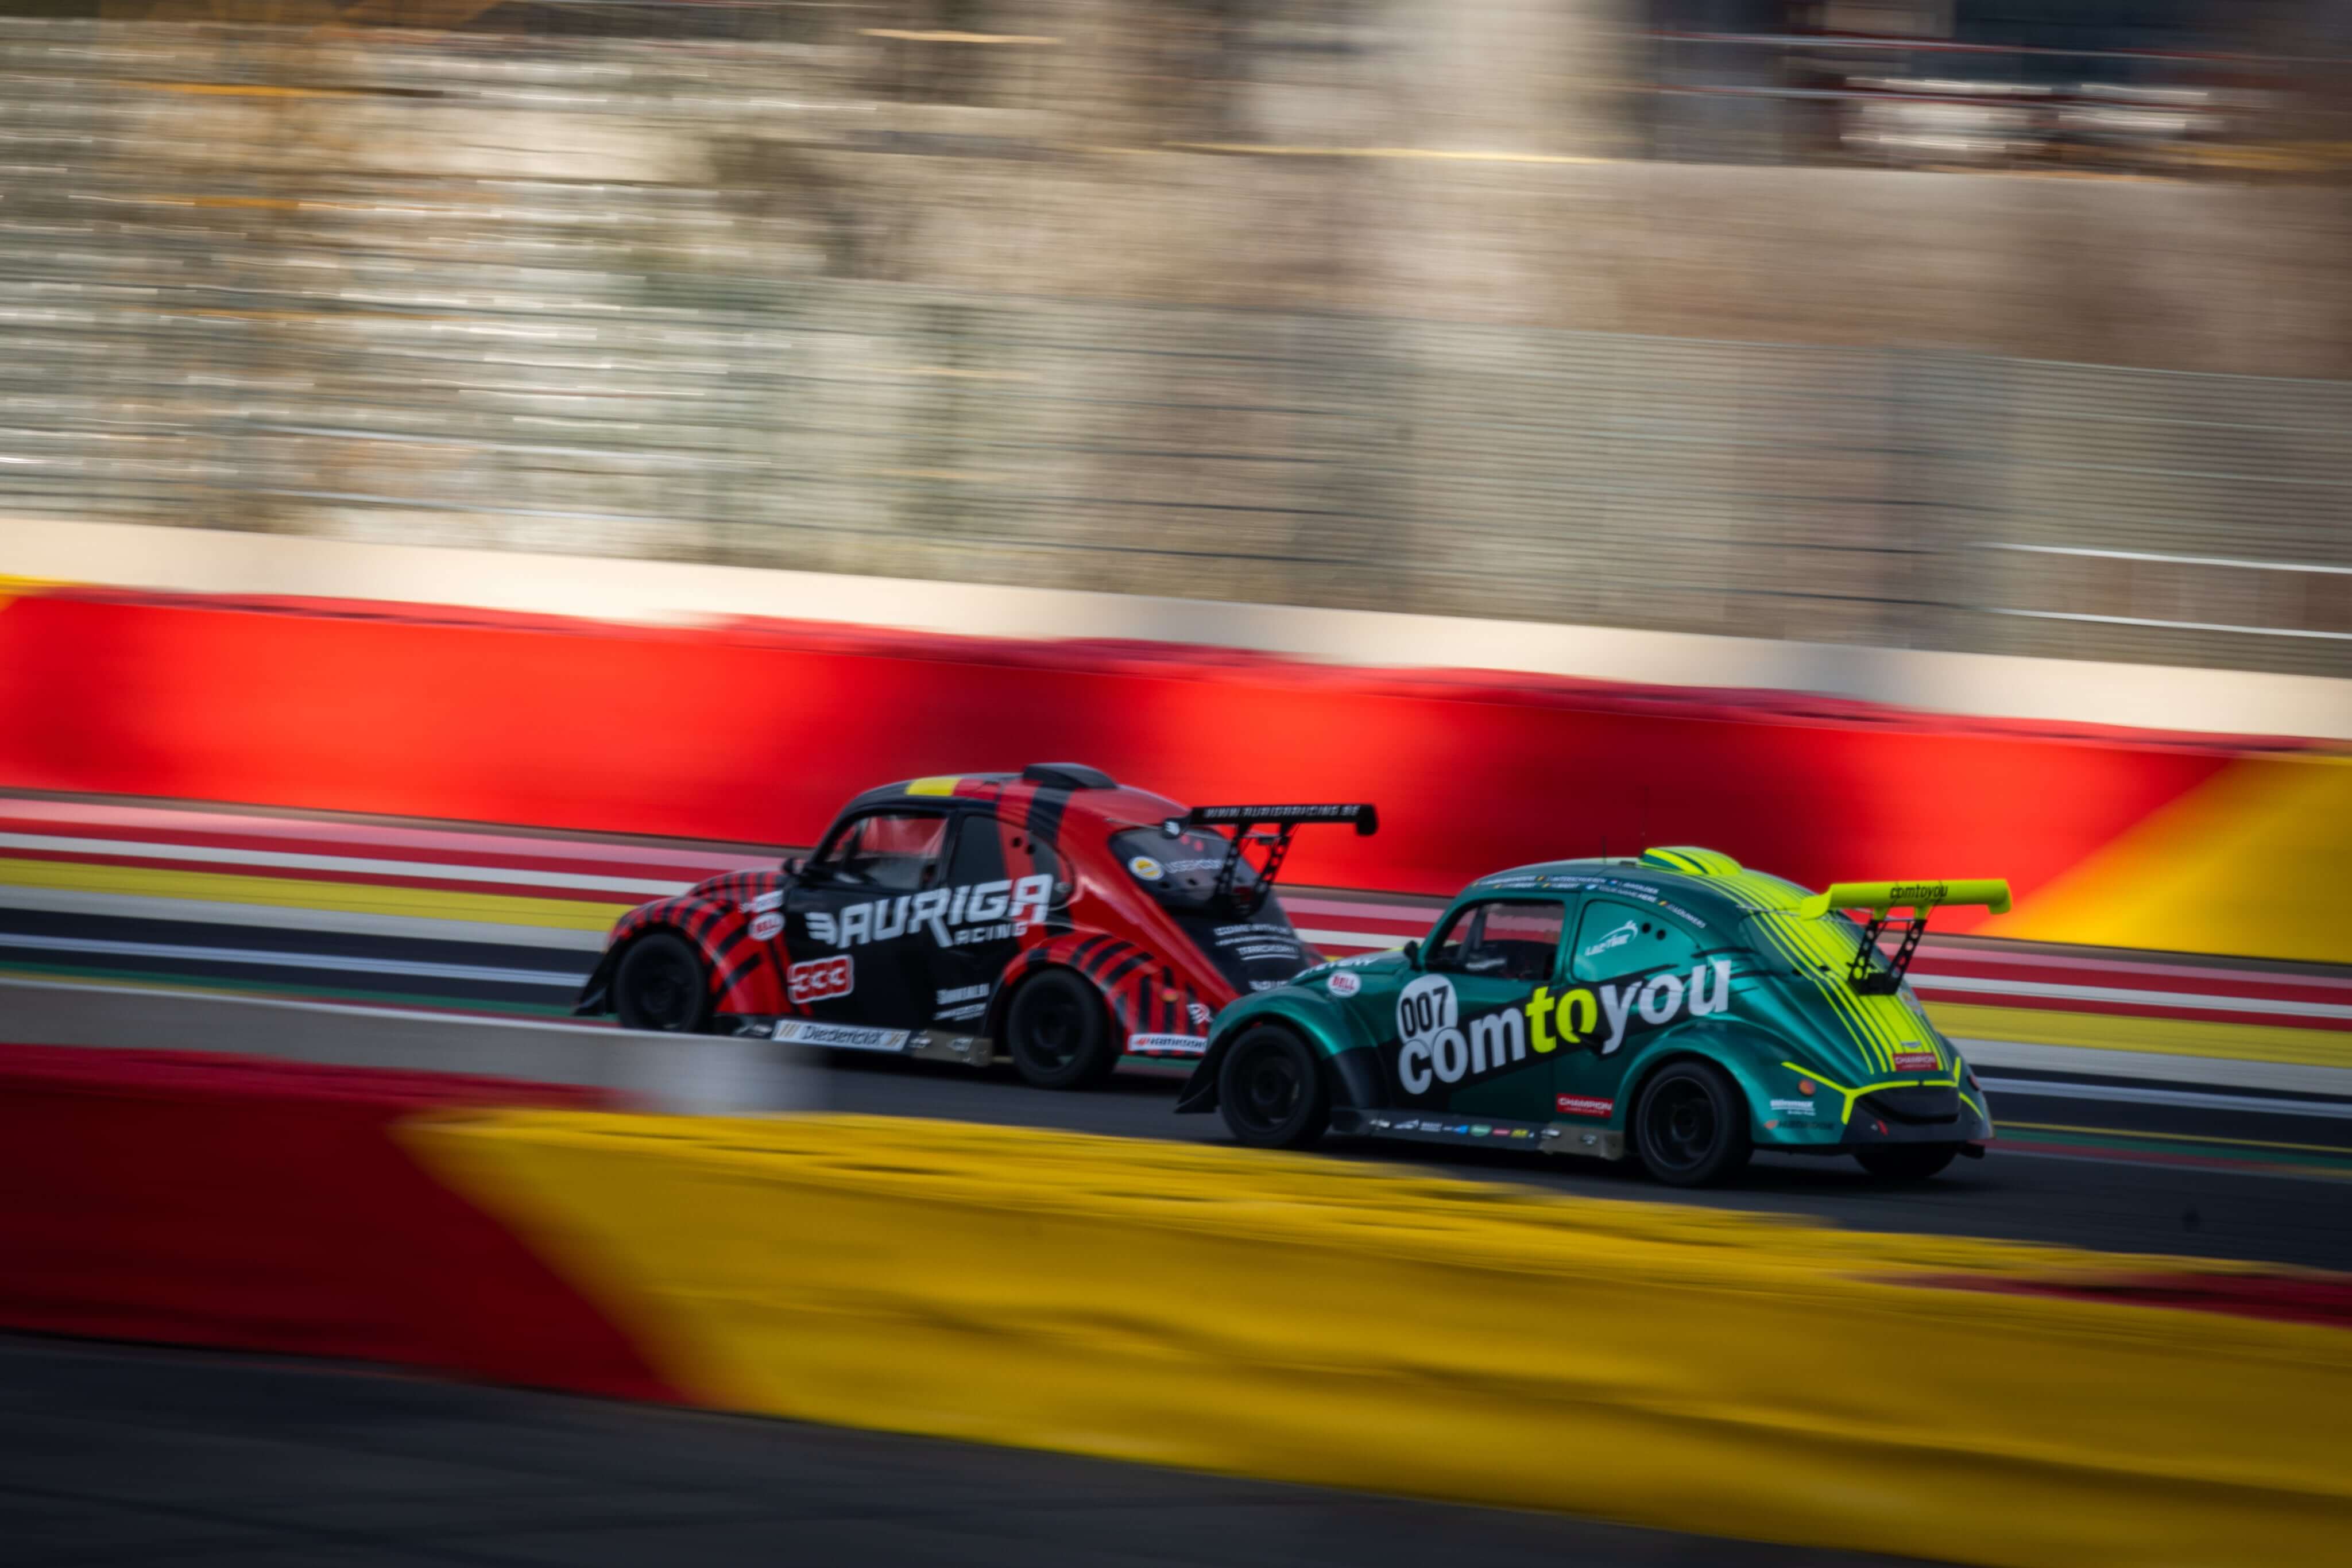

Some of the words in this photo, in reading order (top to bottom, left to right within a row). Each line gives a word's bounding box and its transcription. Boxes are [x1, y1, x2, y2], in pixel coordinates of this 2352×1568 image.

[1890, 884, 1948, 901] comtoyou
[836, 874, 1053, 948] AURIGA
[1330, 974, 1356, 991] BELL
[1398, 959, 1732, 1094] comtoyou
[1401, 985, 1449, 1039] 007
[1558, 1097, 1613, 1110] CHAMPION
